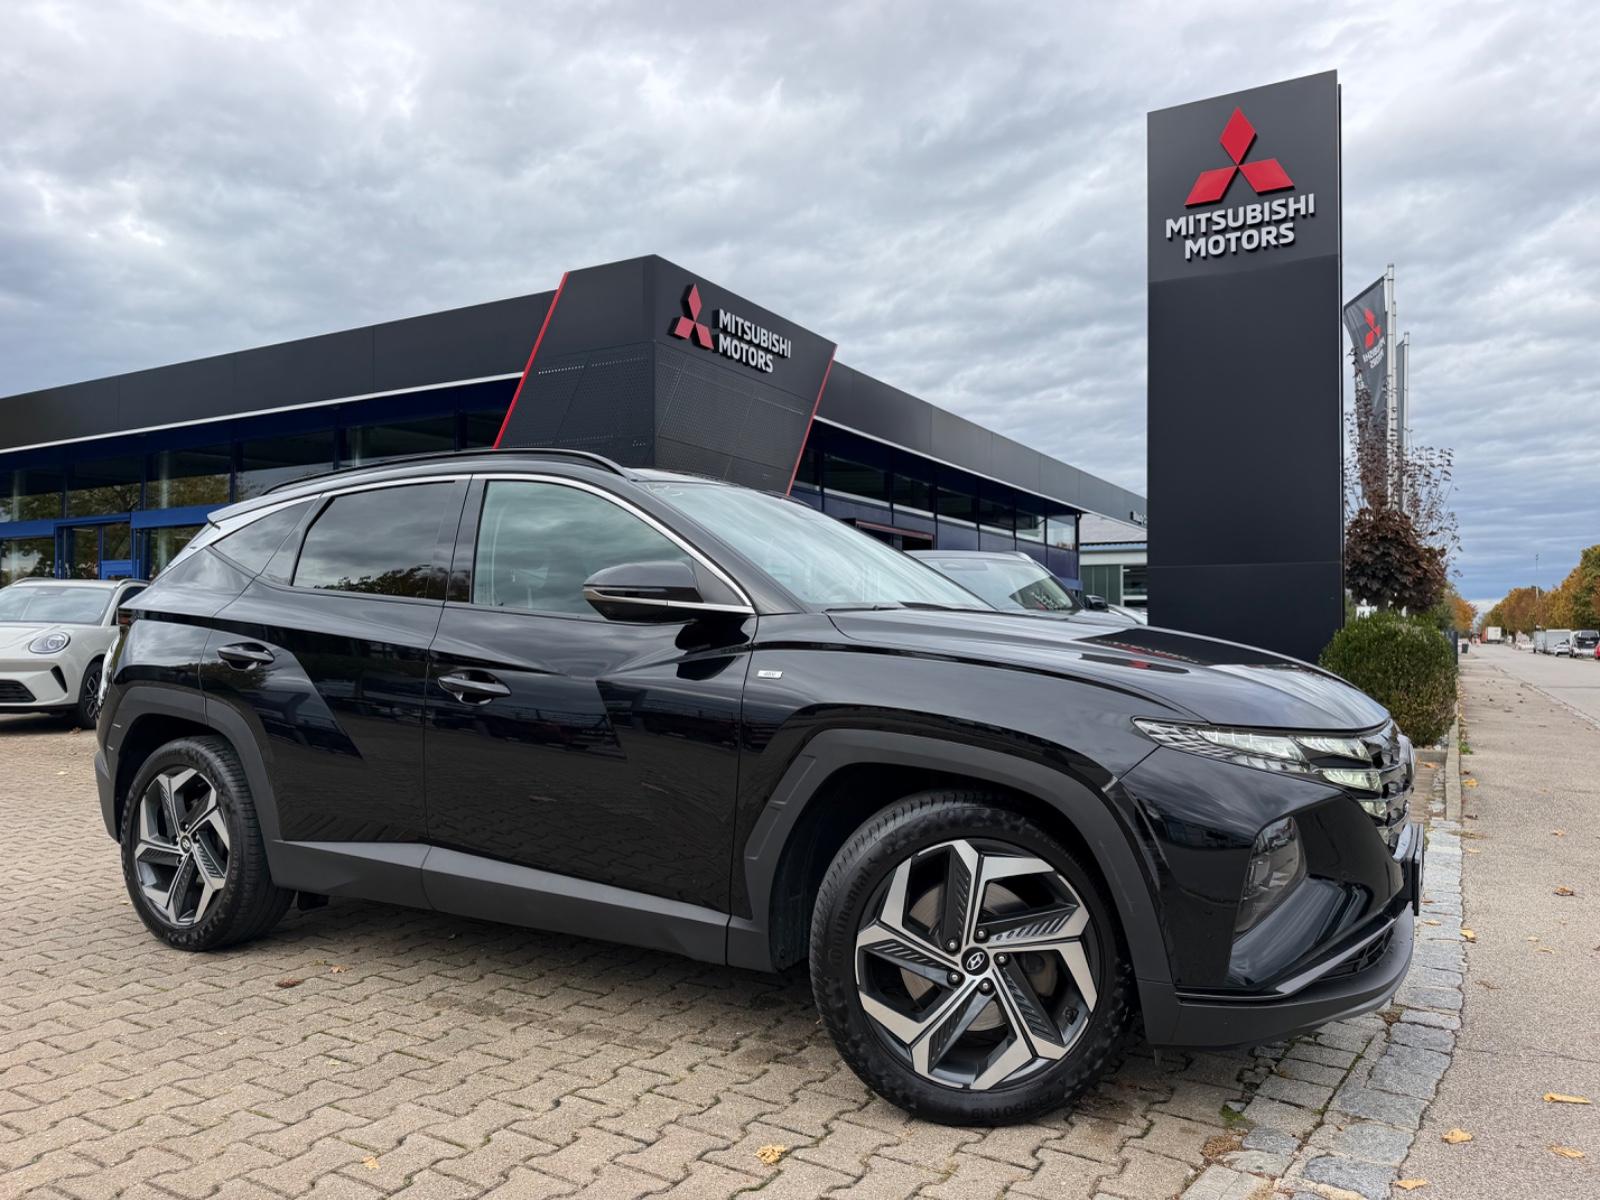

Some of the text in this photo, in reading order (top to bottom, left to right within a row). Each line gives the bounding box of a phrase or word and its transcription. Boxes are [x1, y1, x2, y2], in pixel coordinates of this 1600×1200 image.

[1165, 193, 1315, 239] MITSUBISHI
[1184, 222, 1295, 260] MOTORS
[718, 308, 792, 359] MITSUBISHI
[718, 333, 774, 374] MOTORS
